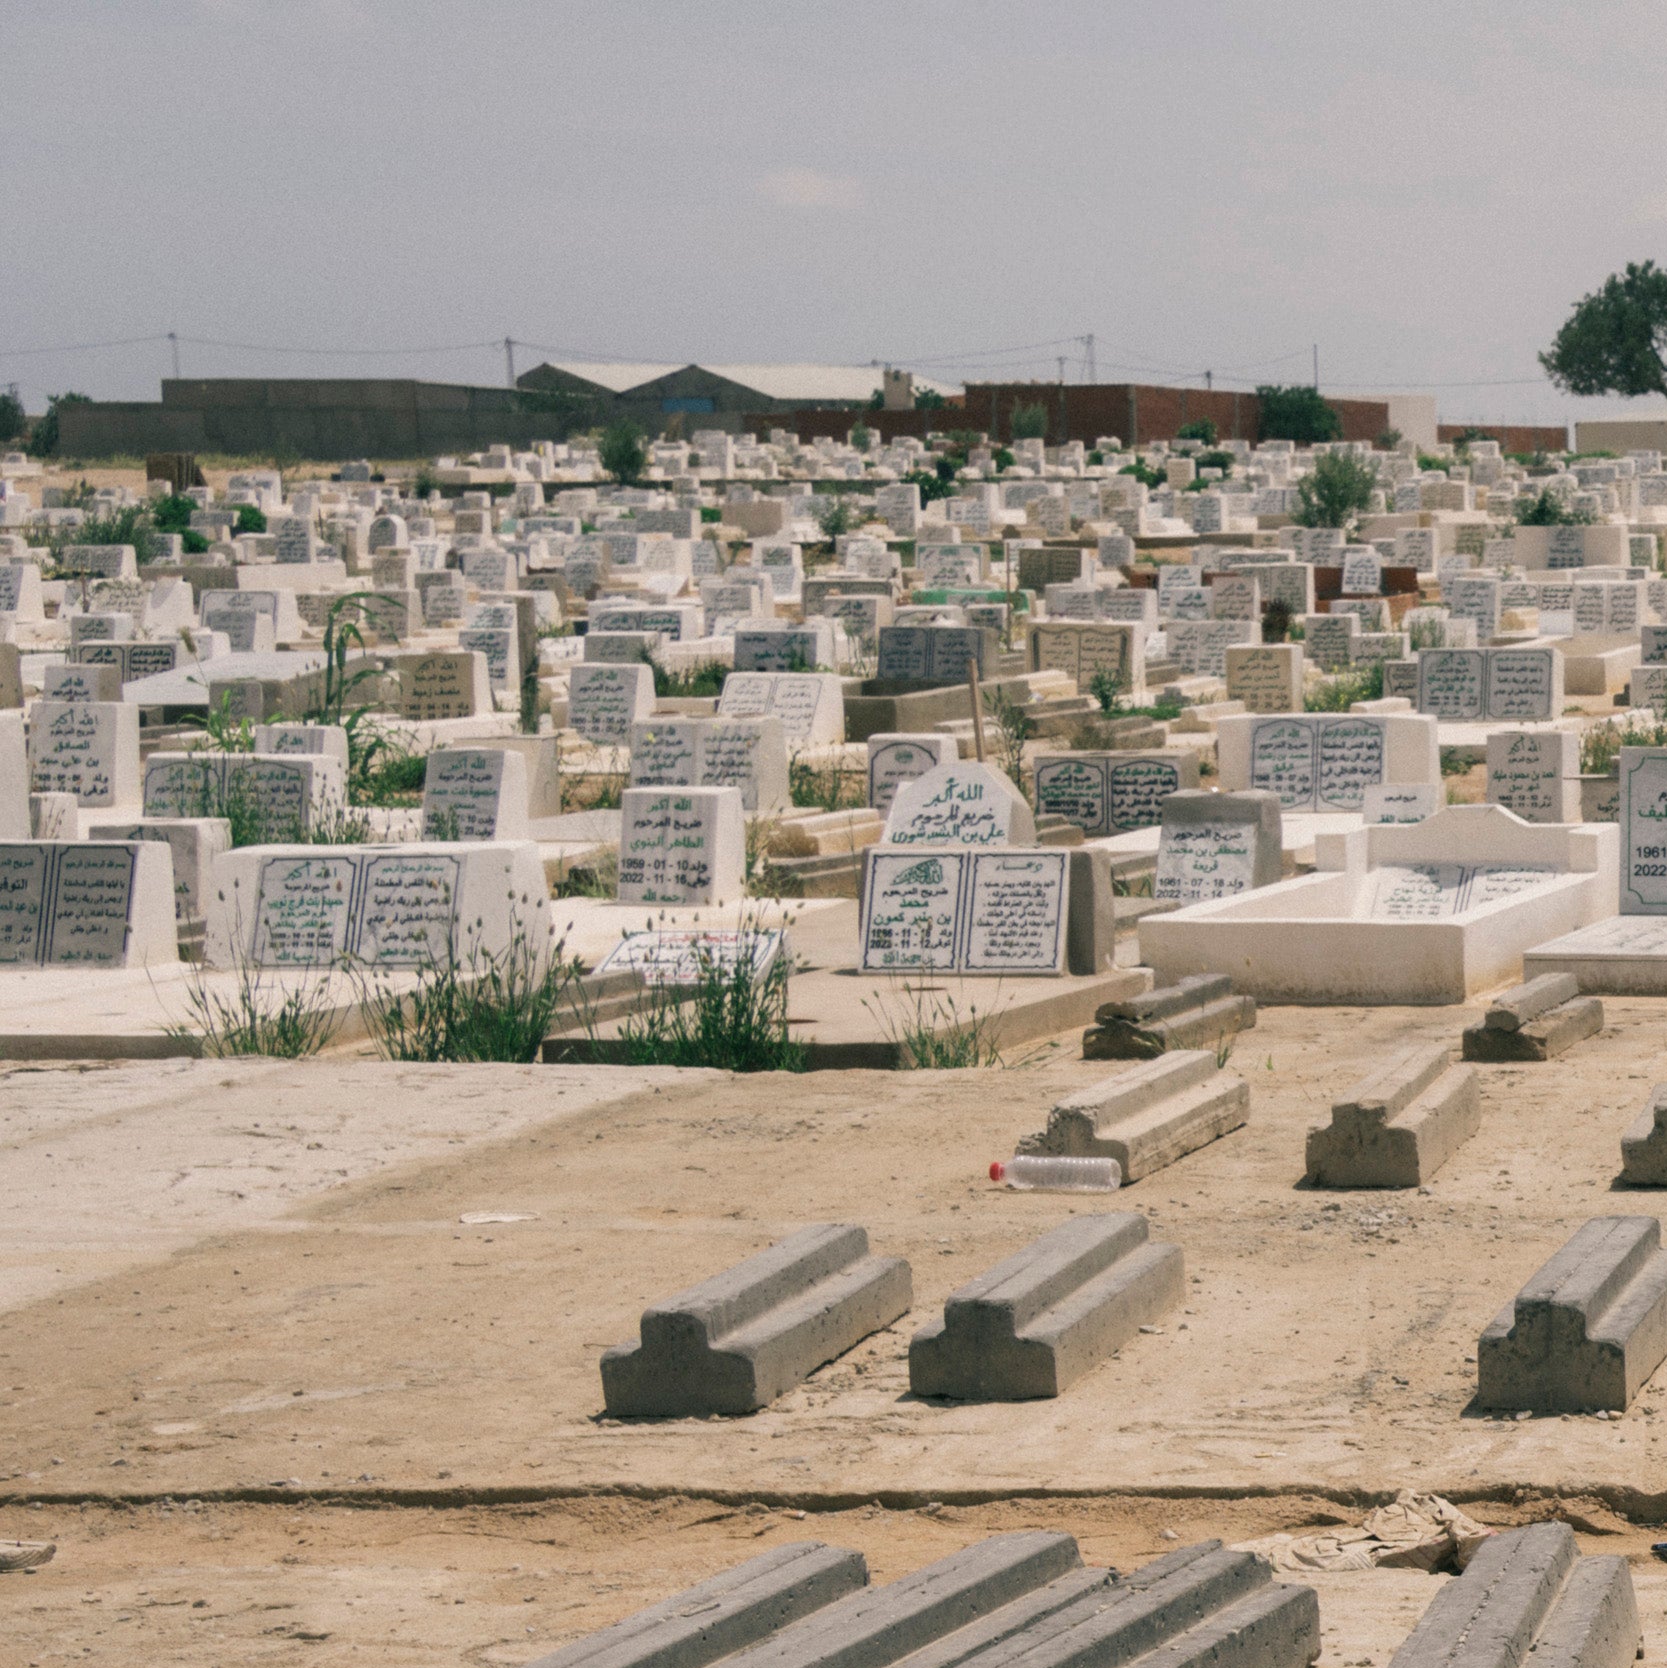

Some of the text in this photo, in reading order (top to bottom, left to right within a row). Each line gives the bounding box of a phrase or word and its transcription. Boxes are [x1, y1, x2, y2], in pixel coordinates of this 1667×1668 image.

[957, 784, 984, 800] الله
[647, 798, 692, 813] الله أكبر
[633, 816, 703, 830] ضريح المرحوم
[1174, 829, 1212, 841] المرحوم
[669, 835, 705, 850] الطاهر
[1636, 846, 1667, 858] 1961
[1634, 864, 1667, 876] 2022
[619, 873, 645, 884] 2022
[883, 887, 948, 897] ضريح المرحوم
[1157, 890, 1181, 898] 2022
[899, 899, 928, 907] محمد
[874, 913, 951, 925] بن كمون
